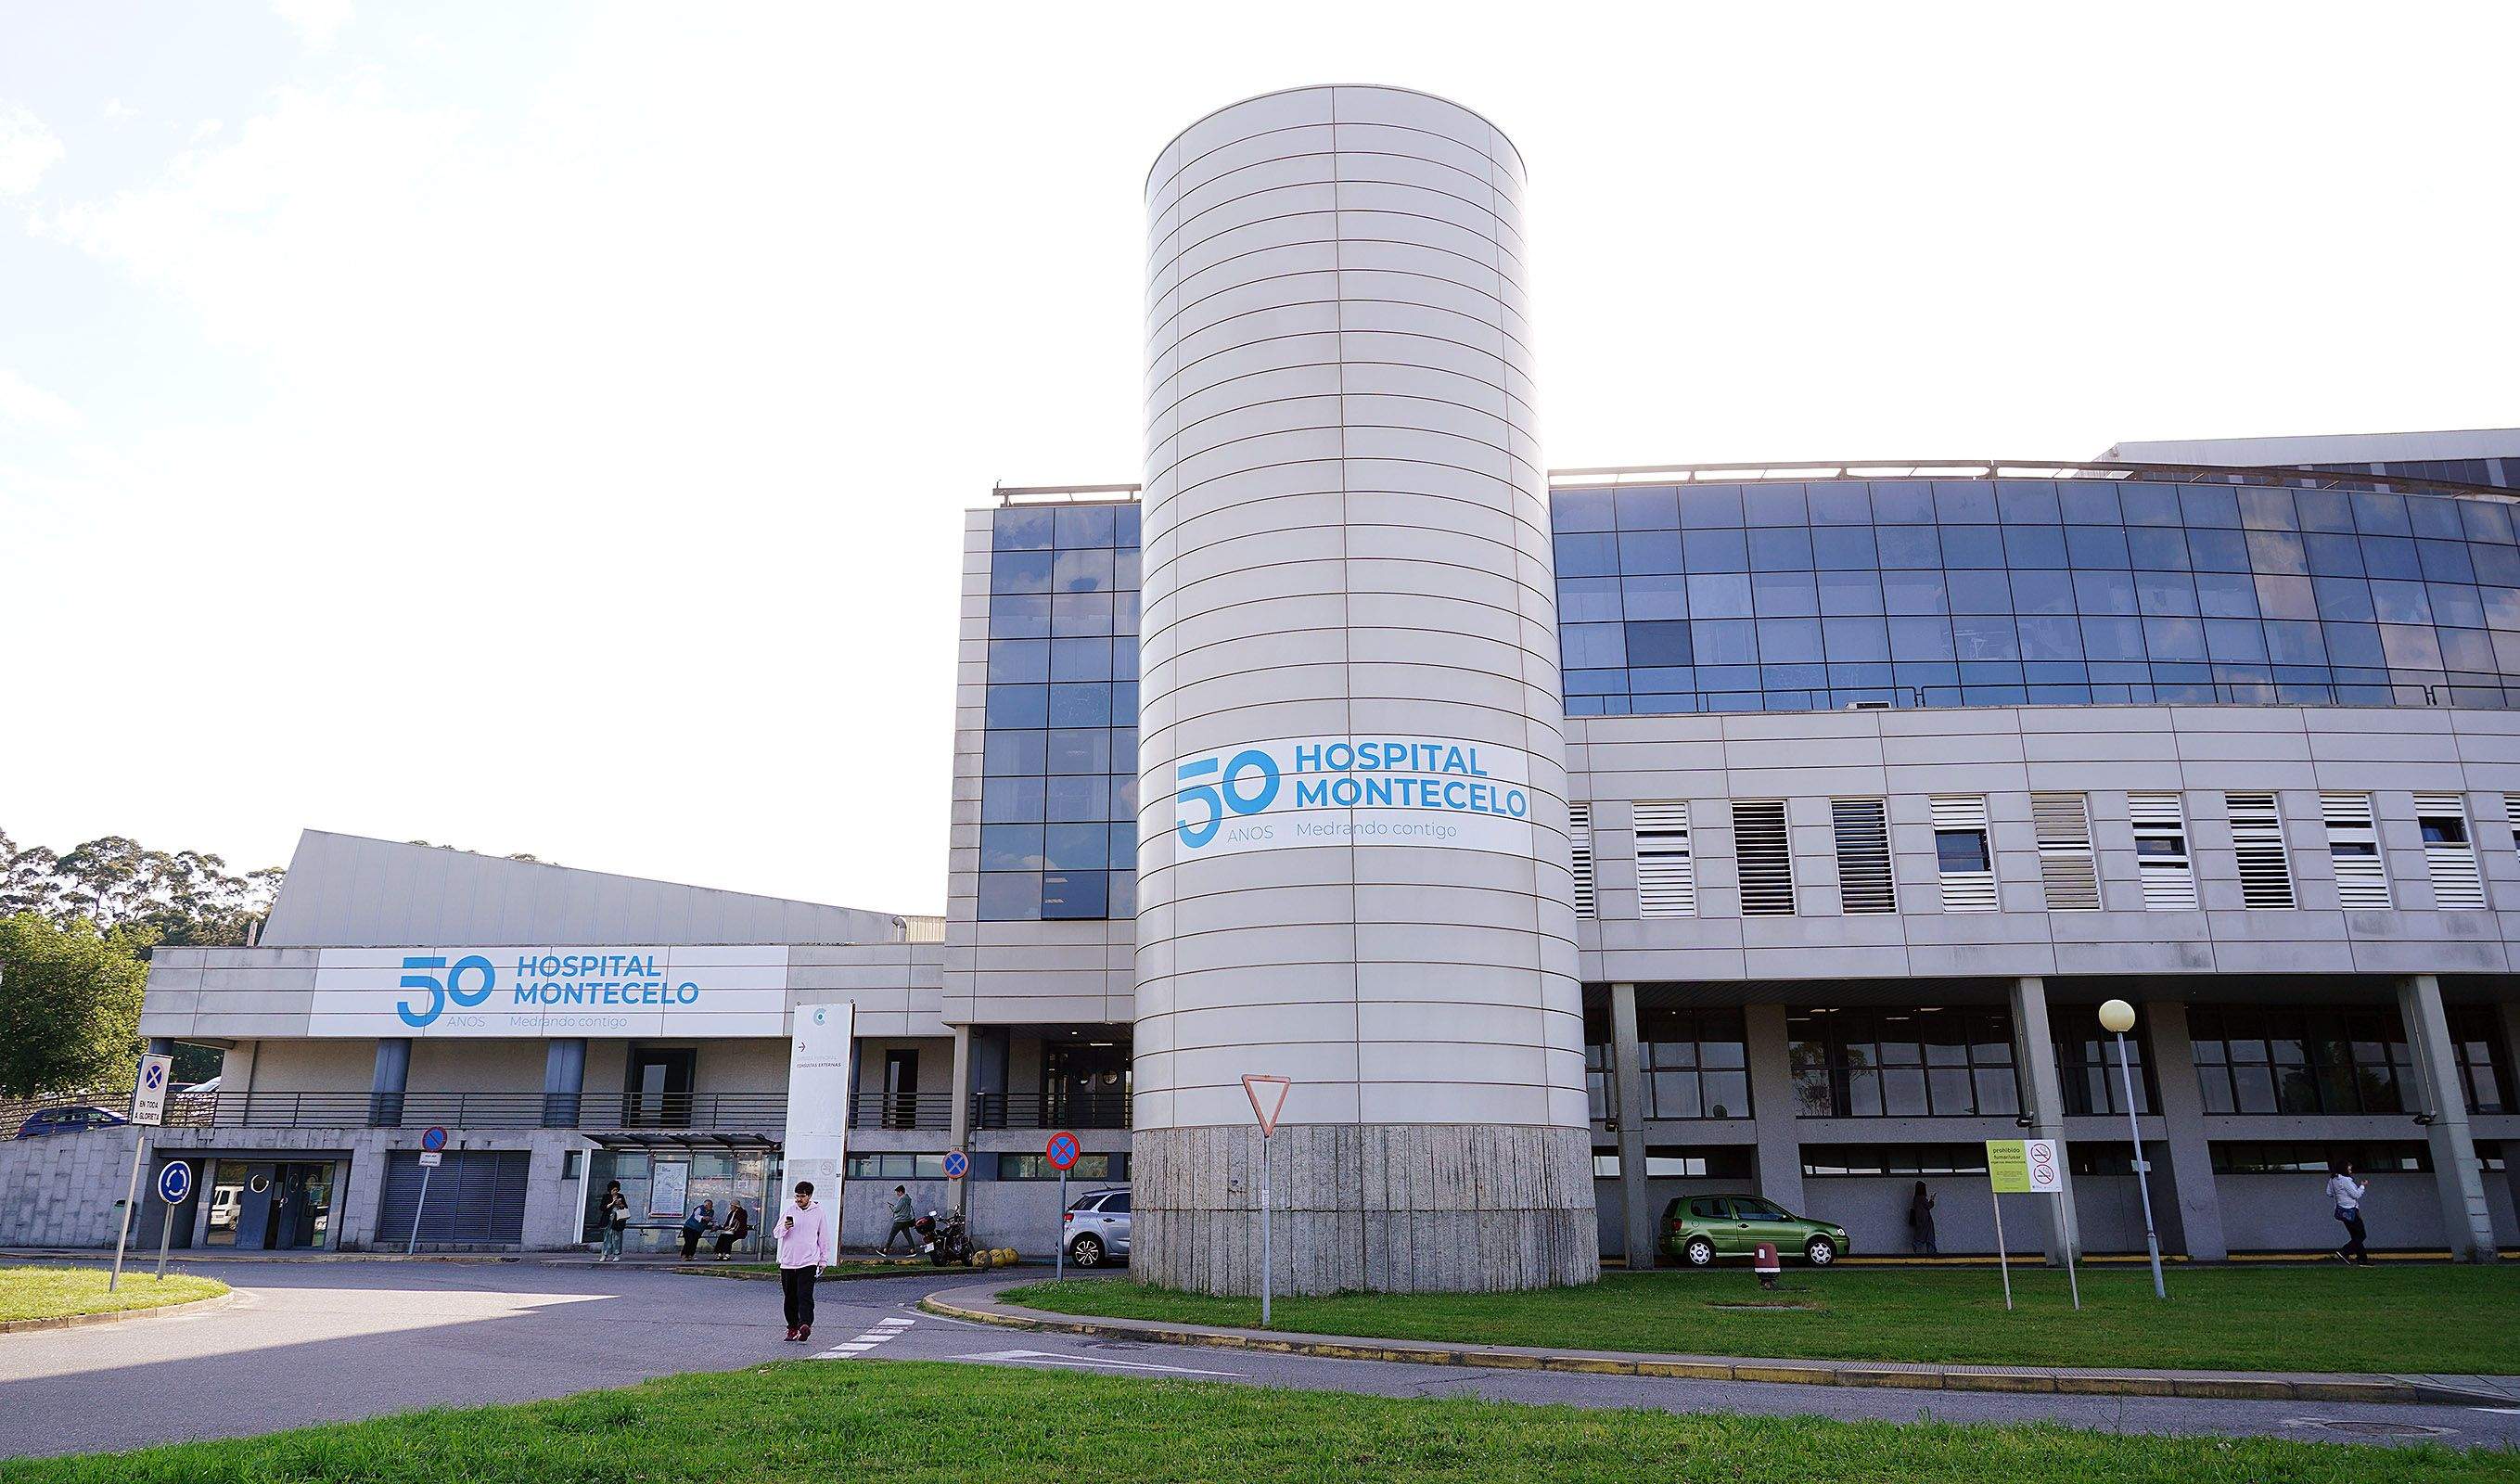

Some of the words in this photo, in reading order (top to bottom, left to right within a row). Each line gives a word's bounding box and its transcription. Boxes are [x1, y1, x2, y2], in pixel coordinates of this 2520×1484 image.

[1296, 742, 1489, 776] HOSPITAL
[1177, 749, 1281, 849] 50
[1296, 777, 1527, 818] MONTECELO
[1227, 825, 1274, 843] ANOS
[1296, 820, 1388, 837] Medrando
[1392, 822, 1458, 840] contigo
[517, 955, 662, 978] HOSPITAL
[396, 954, 496, 1029] 50
[514, 981, 699, 1005] MONTECELO
[446, 1016, 487, 1028] ANOS
[509, 1015, 575, 1028] Medrando
[578, 1016, 628, 1030] contigo
